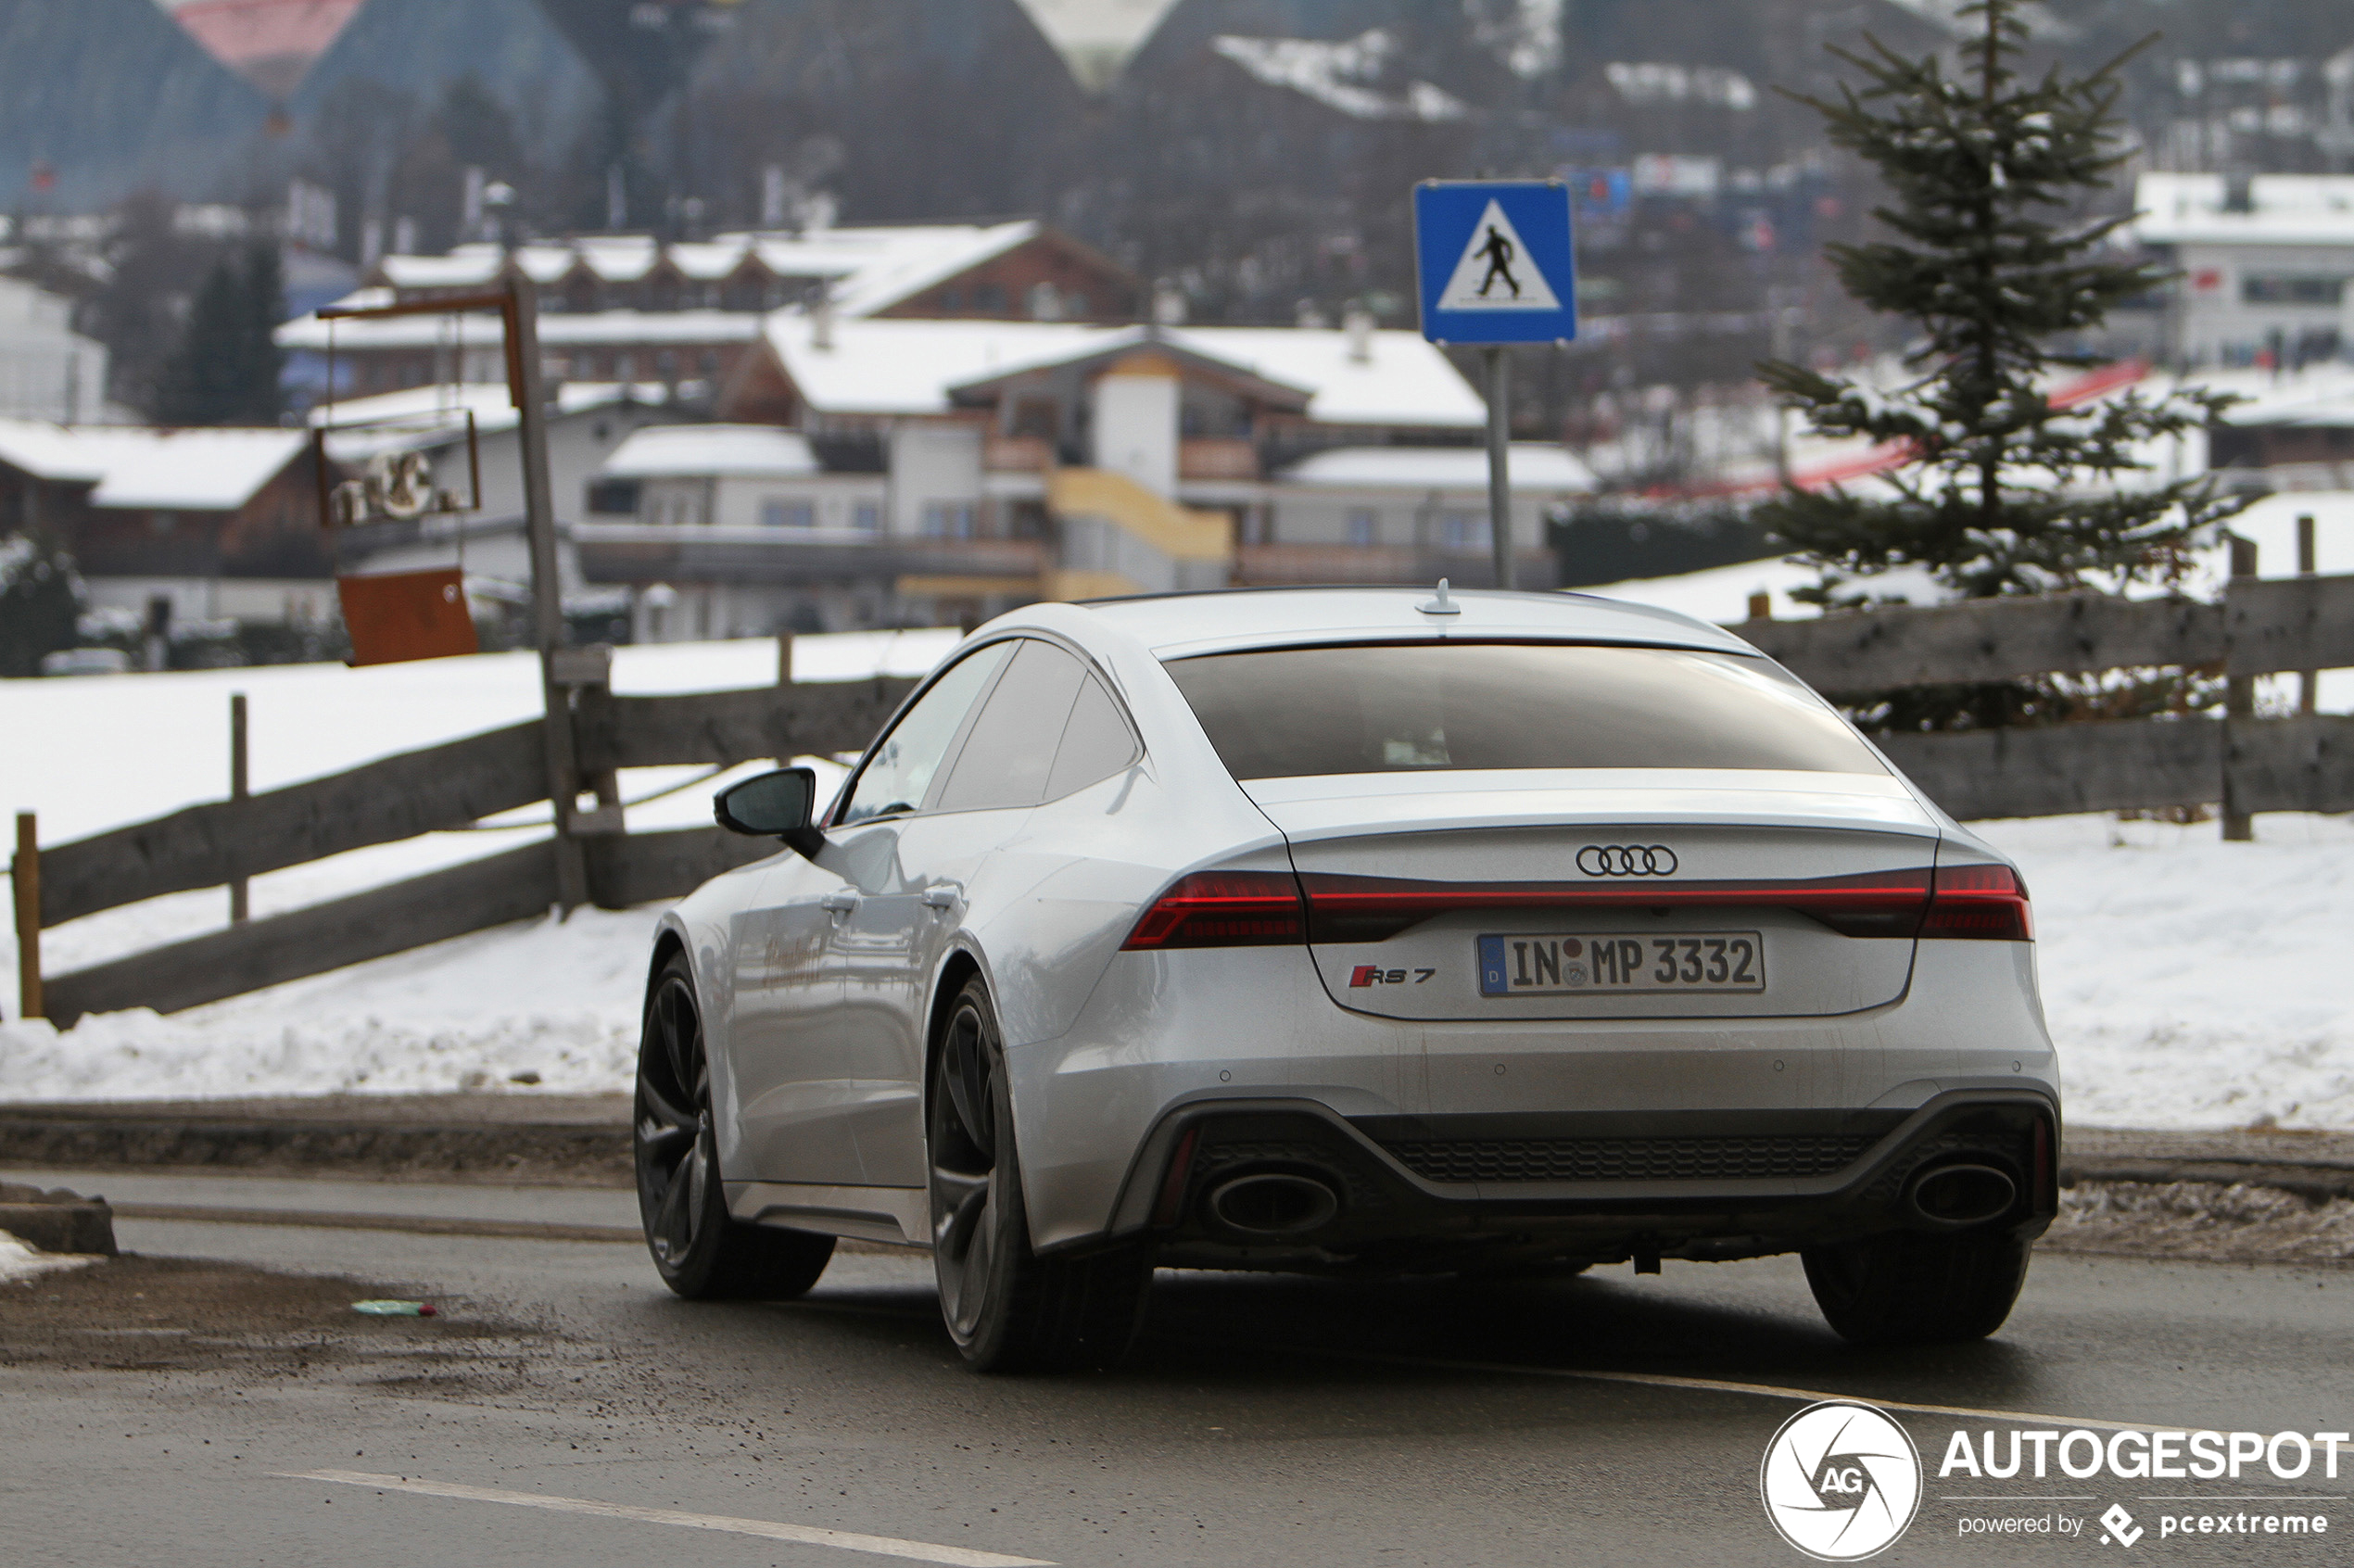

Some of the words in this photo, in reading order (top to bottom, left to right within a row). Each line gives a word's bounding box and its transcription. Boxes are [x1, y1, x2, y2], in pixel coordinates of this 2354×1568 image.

[1512, 941, 1561, 986] IN
[1591, 939, 1642, 984] MP
[1652, 939, 1756, 983] 3332
[1361, 968, 1407, 984] RS
[1413, 967, 1436, 983] 7
[1488, 970, 1499, 982] D
